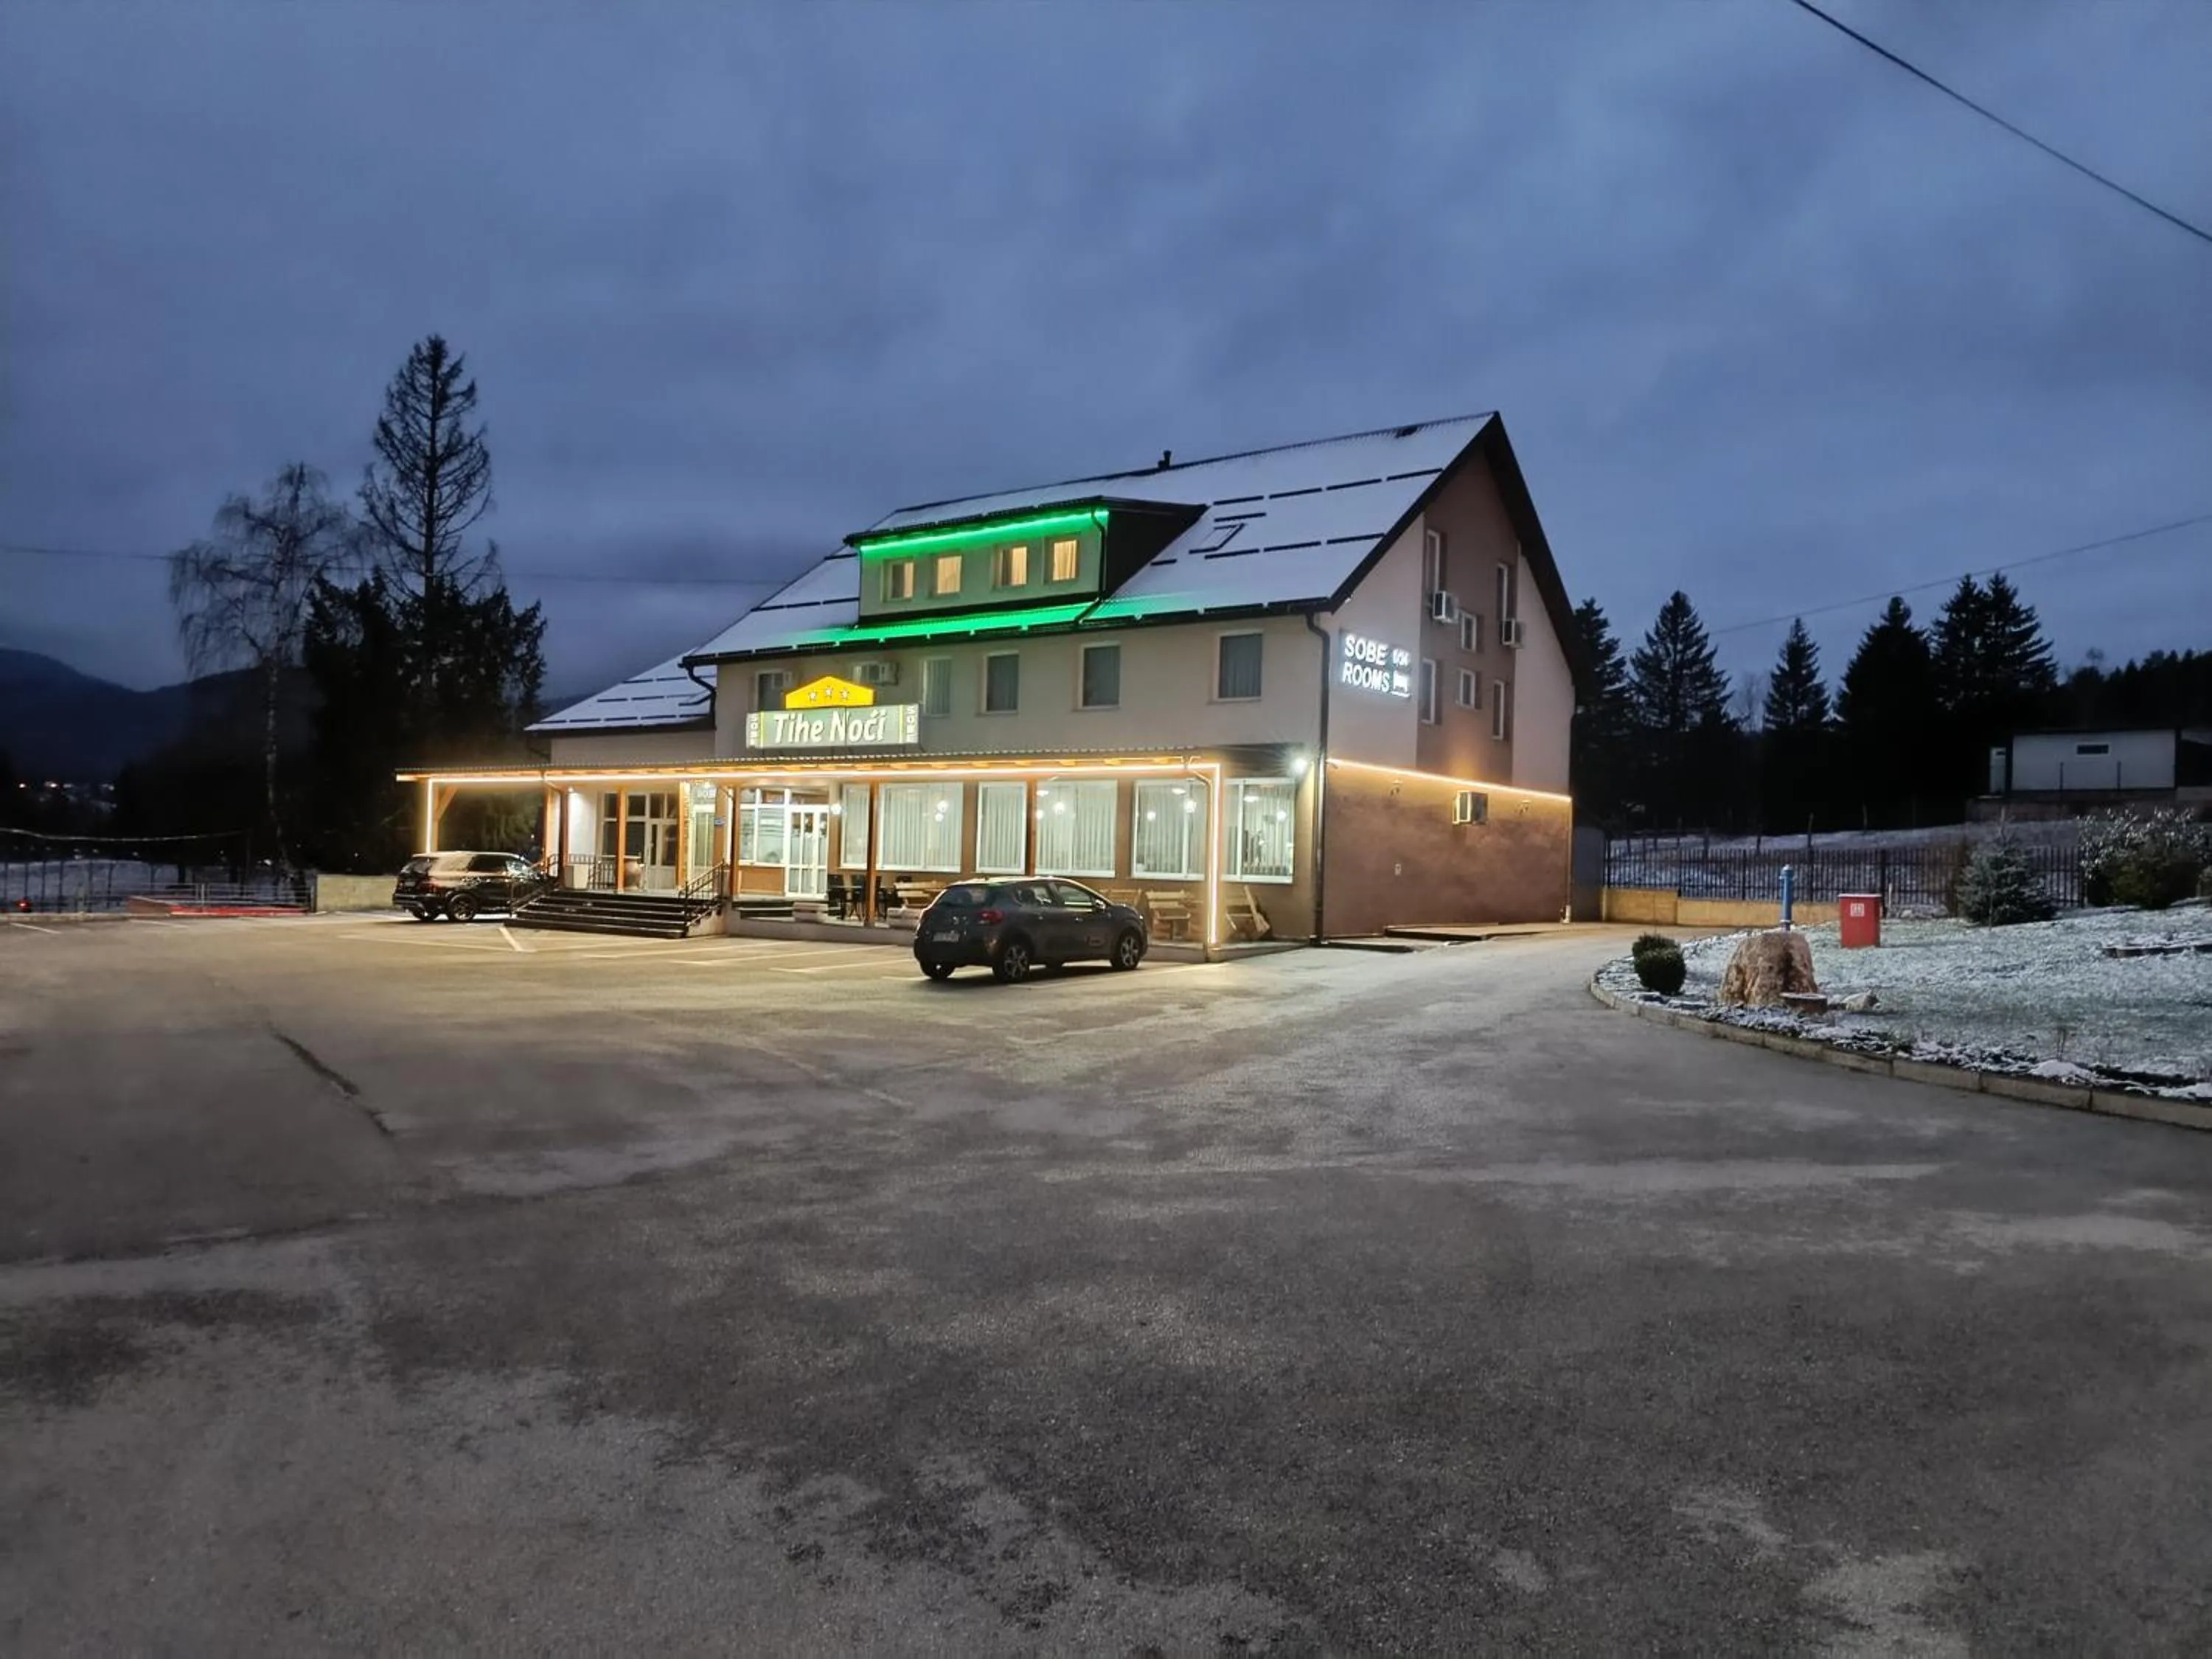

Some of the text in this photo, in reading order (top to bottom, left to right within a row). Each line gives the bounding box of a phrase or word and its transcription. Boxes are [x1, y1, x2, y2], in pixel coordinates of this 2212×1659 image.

[1345, 634, 1388, 666] SOBE
[1342, 661, 1391, 692] ROOMS
[774, 709, 886, 744] Tihe Noći
